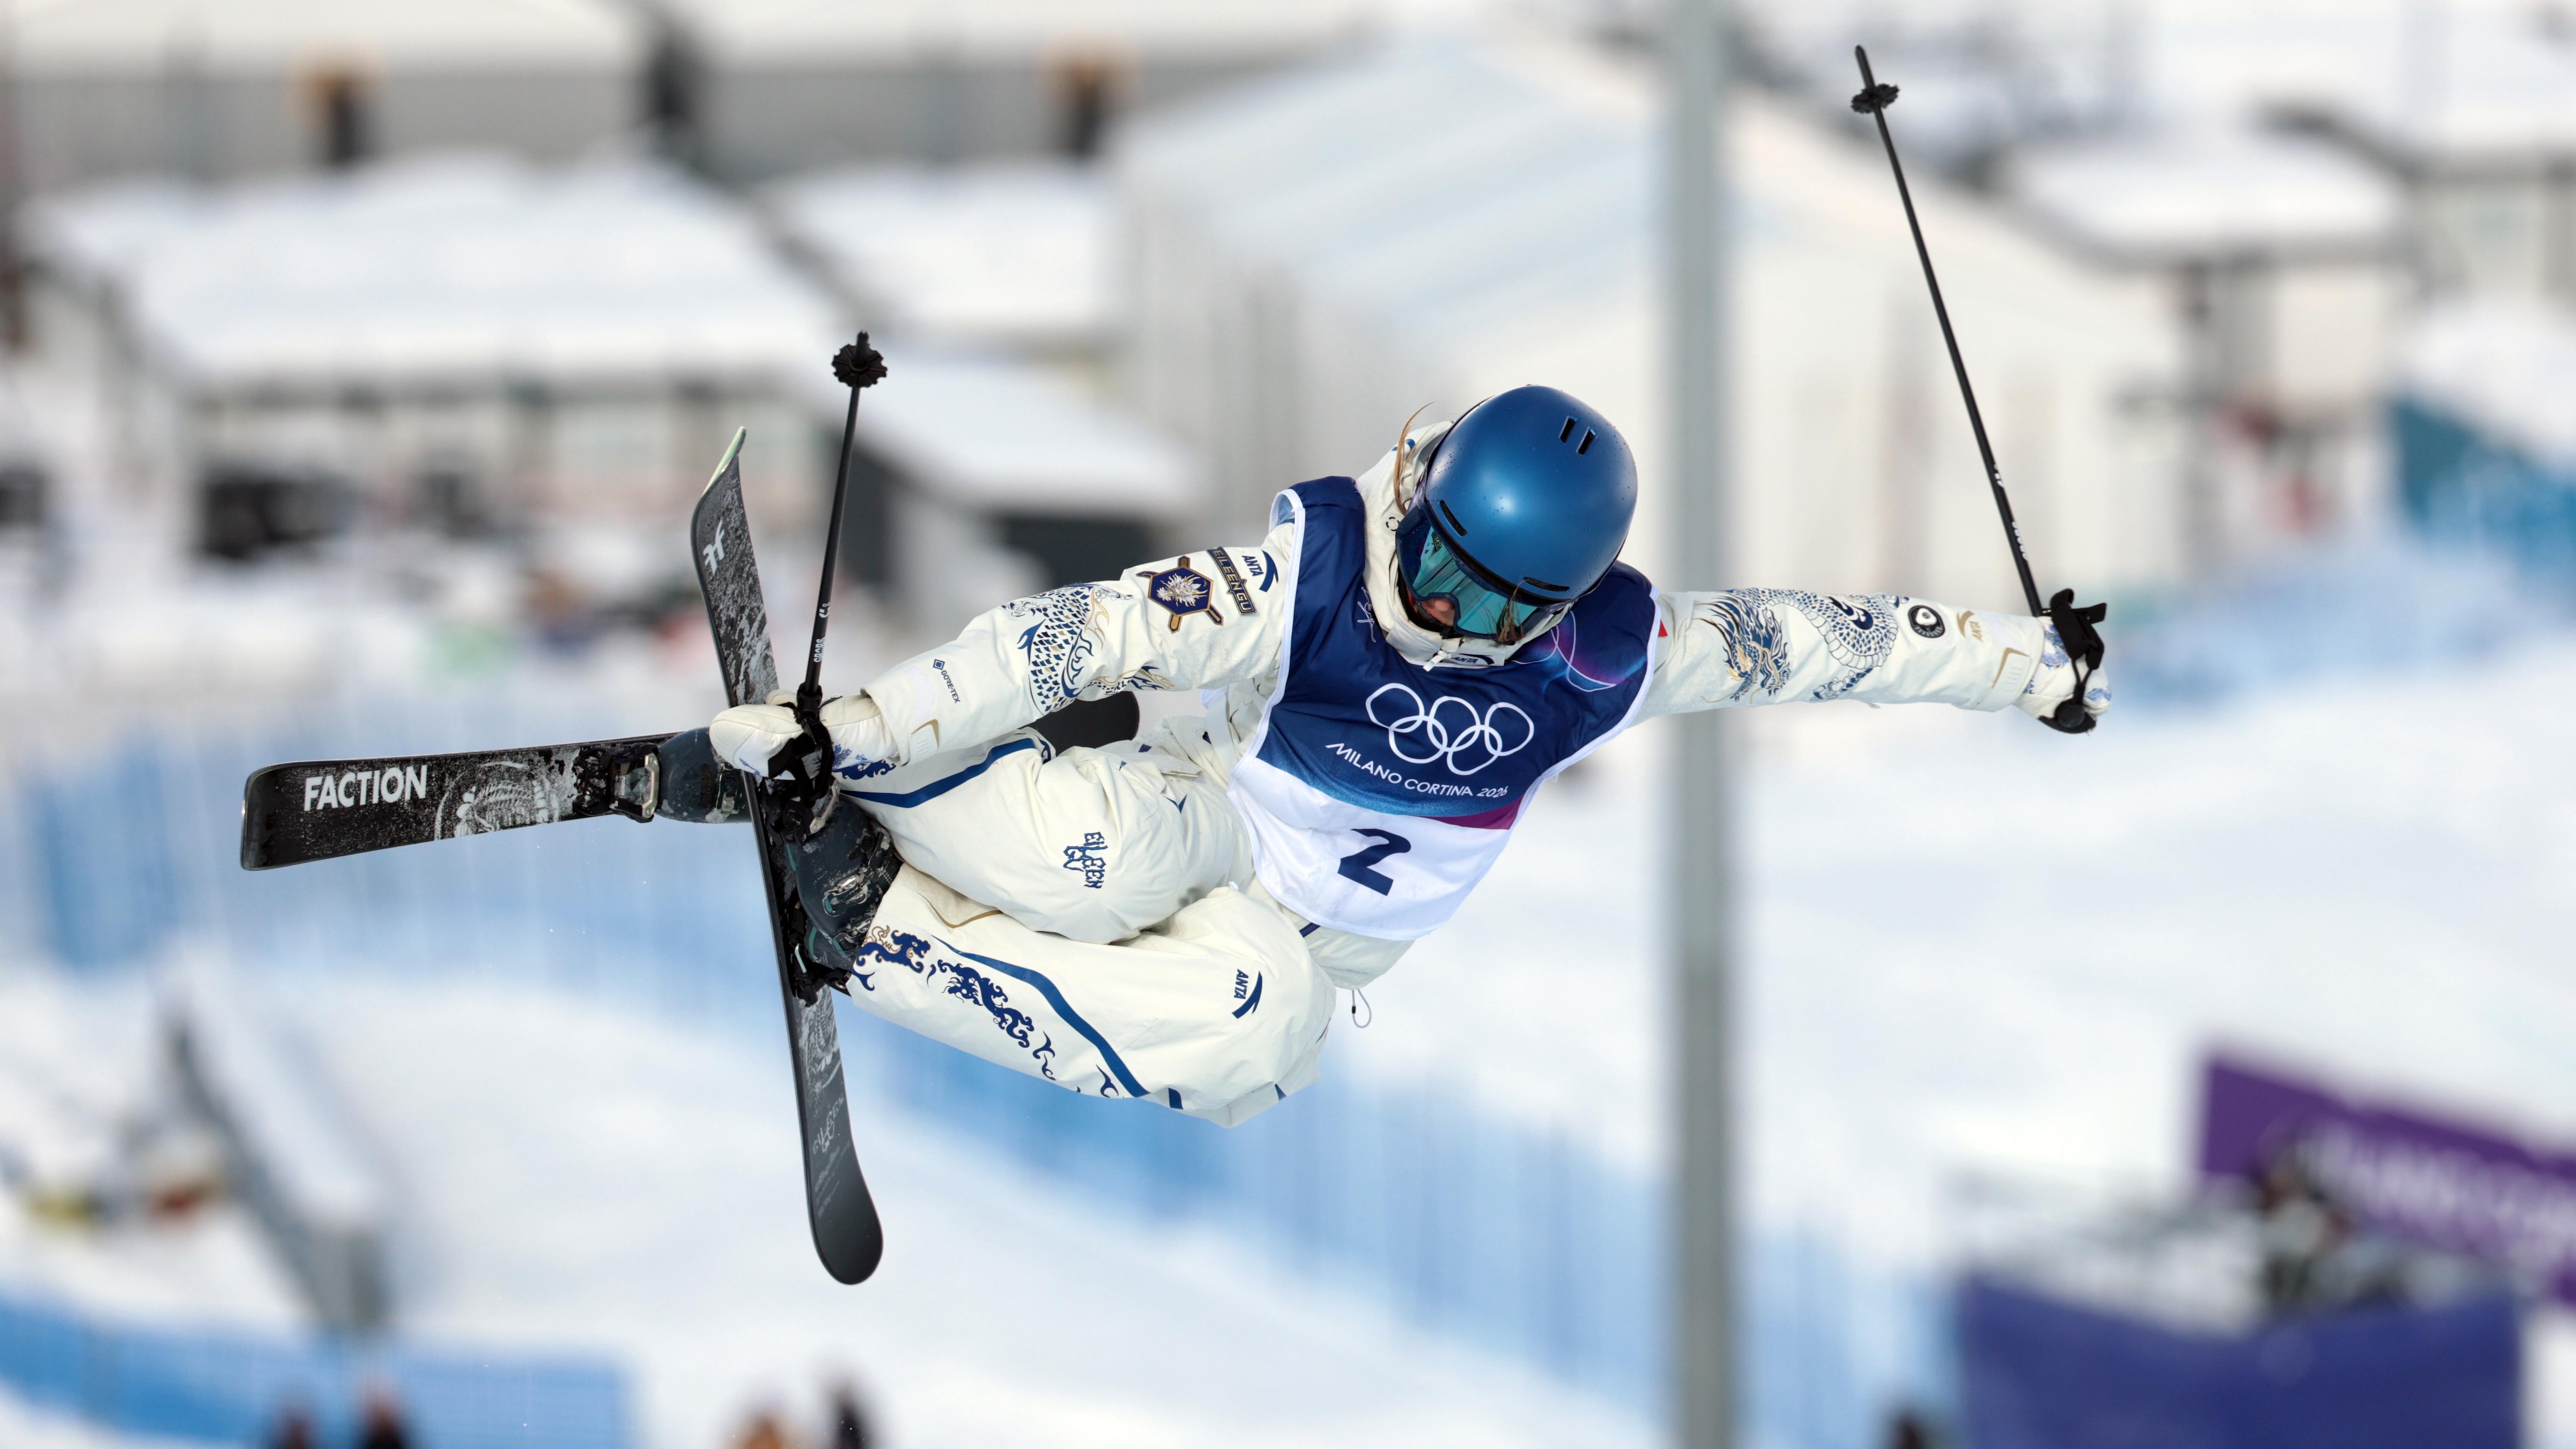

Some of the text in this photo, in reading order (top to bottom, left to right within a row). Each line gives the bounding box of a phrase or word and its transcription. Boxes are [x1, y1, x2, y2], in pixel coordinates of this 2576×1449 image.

[1212, 550, 1252, 610] EILEEN GU
[1242, 555, 1264, 576] ANTA
[1969, 621, 1984, 642] ANTA
[941, 670, 960, 704] GORE-TEX
[304, 765, 427, 812] FACTION
[1326, 743, 1508, 798] MILANO CORTINA 2026
[1337, 828, 1412, 896] 2
[1234, 968, 1248, 999] ANTA
